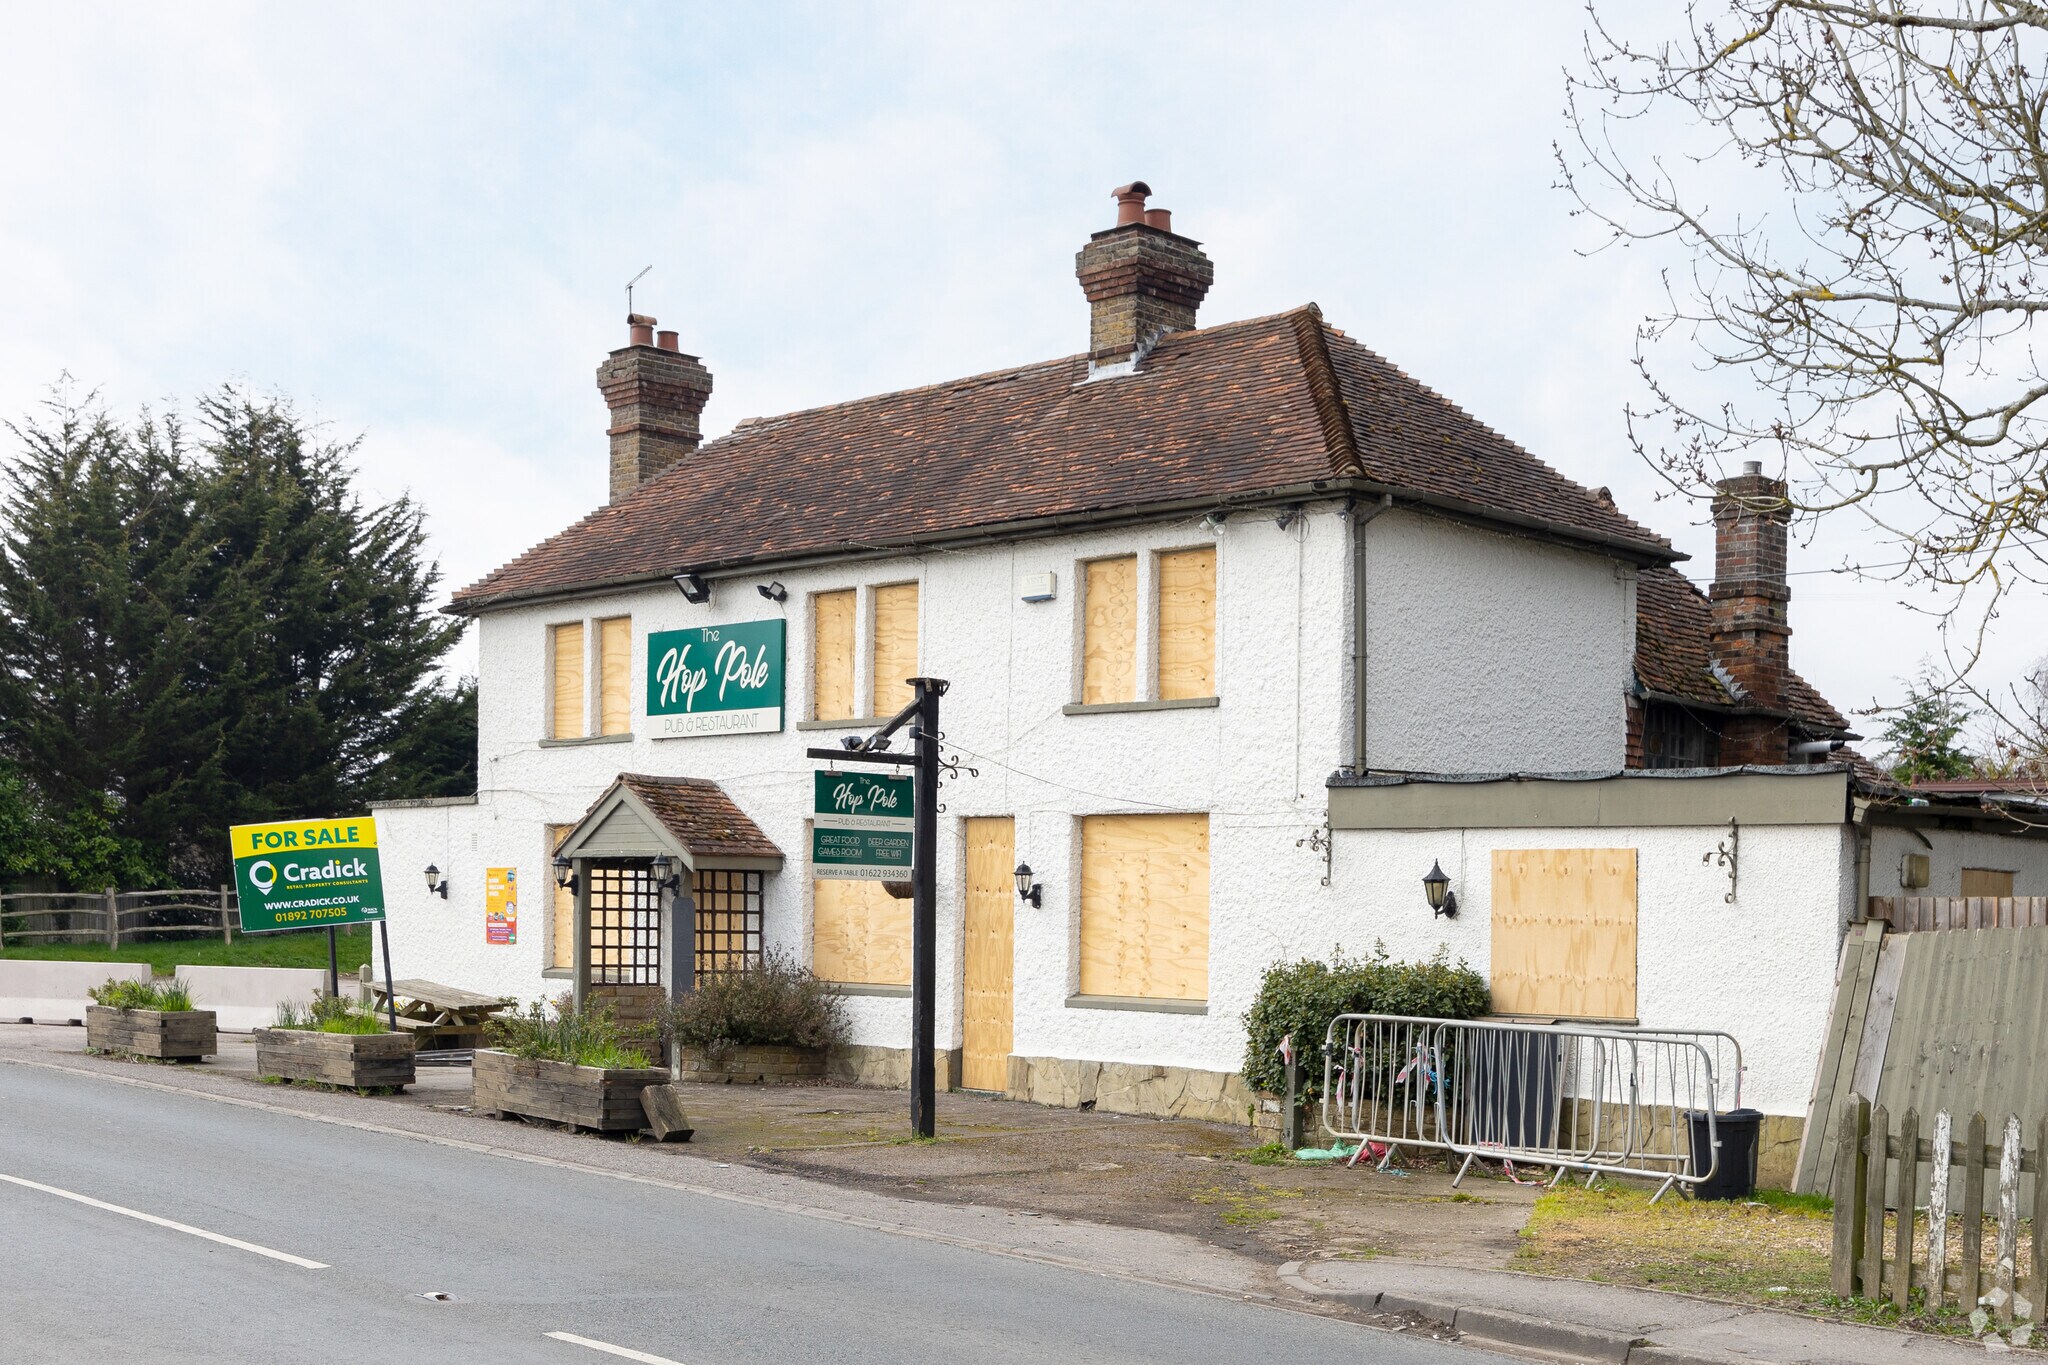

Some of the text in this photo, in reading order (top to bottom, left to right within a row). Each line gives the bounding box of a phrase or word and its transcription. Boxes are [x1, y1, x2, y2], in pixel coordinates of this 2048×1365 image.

[701, 628, 720, 643] The
[656, 640, 769, 712] Hop Pole
[664, 712, 759, 733] PUB & RESTAURANT
[860, 776, 870, 785] The
[832, 783, 898, 814] Hop Pole
[838, 818, 850, 826] PUB
[856, 819, 891, 827] RESTAURANT
[251, 826, 360, 849] FOR SALE
[820, 835, 861, 845] GREAT FOOD
[867, 838, 910, 847] BEER GARDEN
[818, 847, 862, 857] GAMES ROOM
[875, 849, 890, 857] FREE
[283, 857, 368, 882] Cradick
[860, 869, 883, 877] 01622
[883, 869, 909, 878] 934360
[264, 895, 360, 910] WWW.CRADICK.CO.UK
[275, 907, 348, 923] 01892 707505
